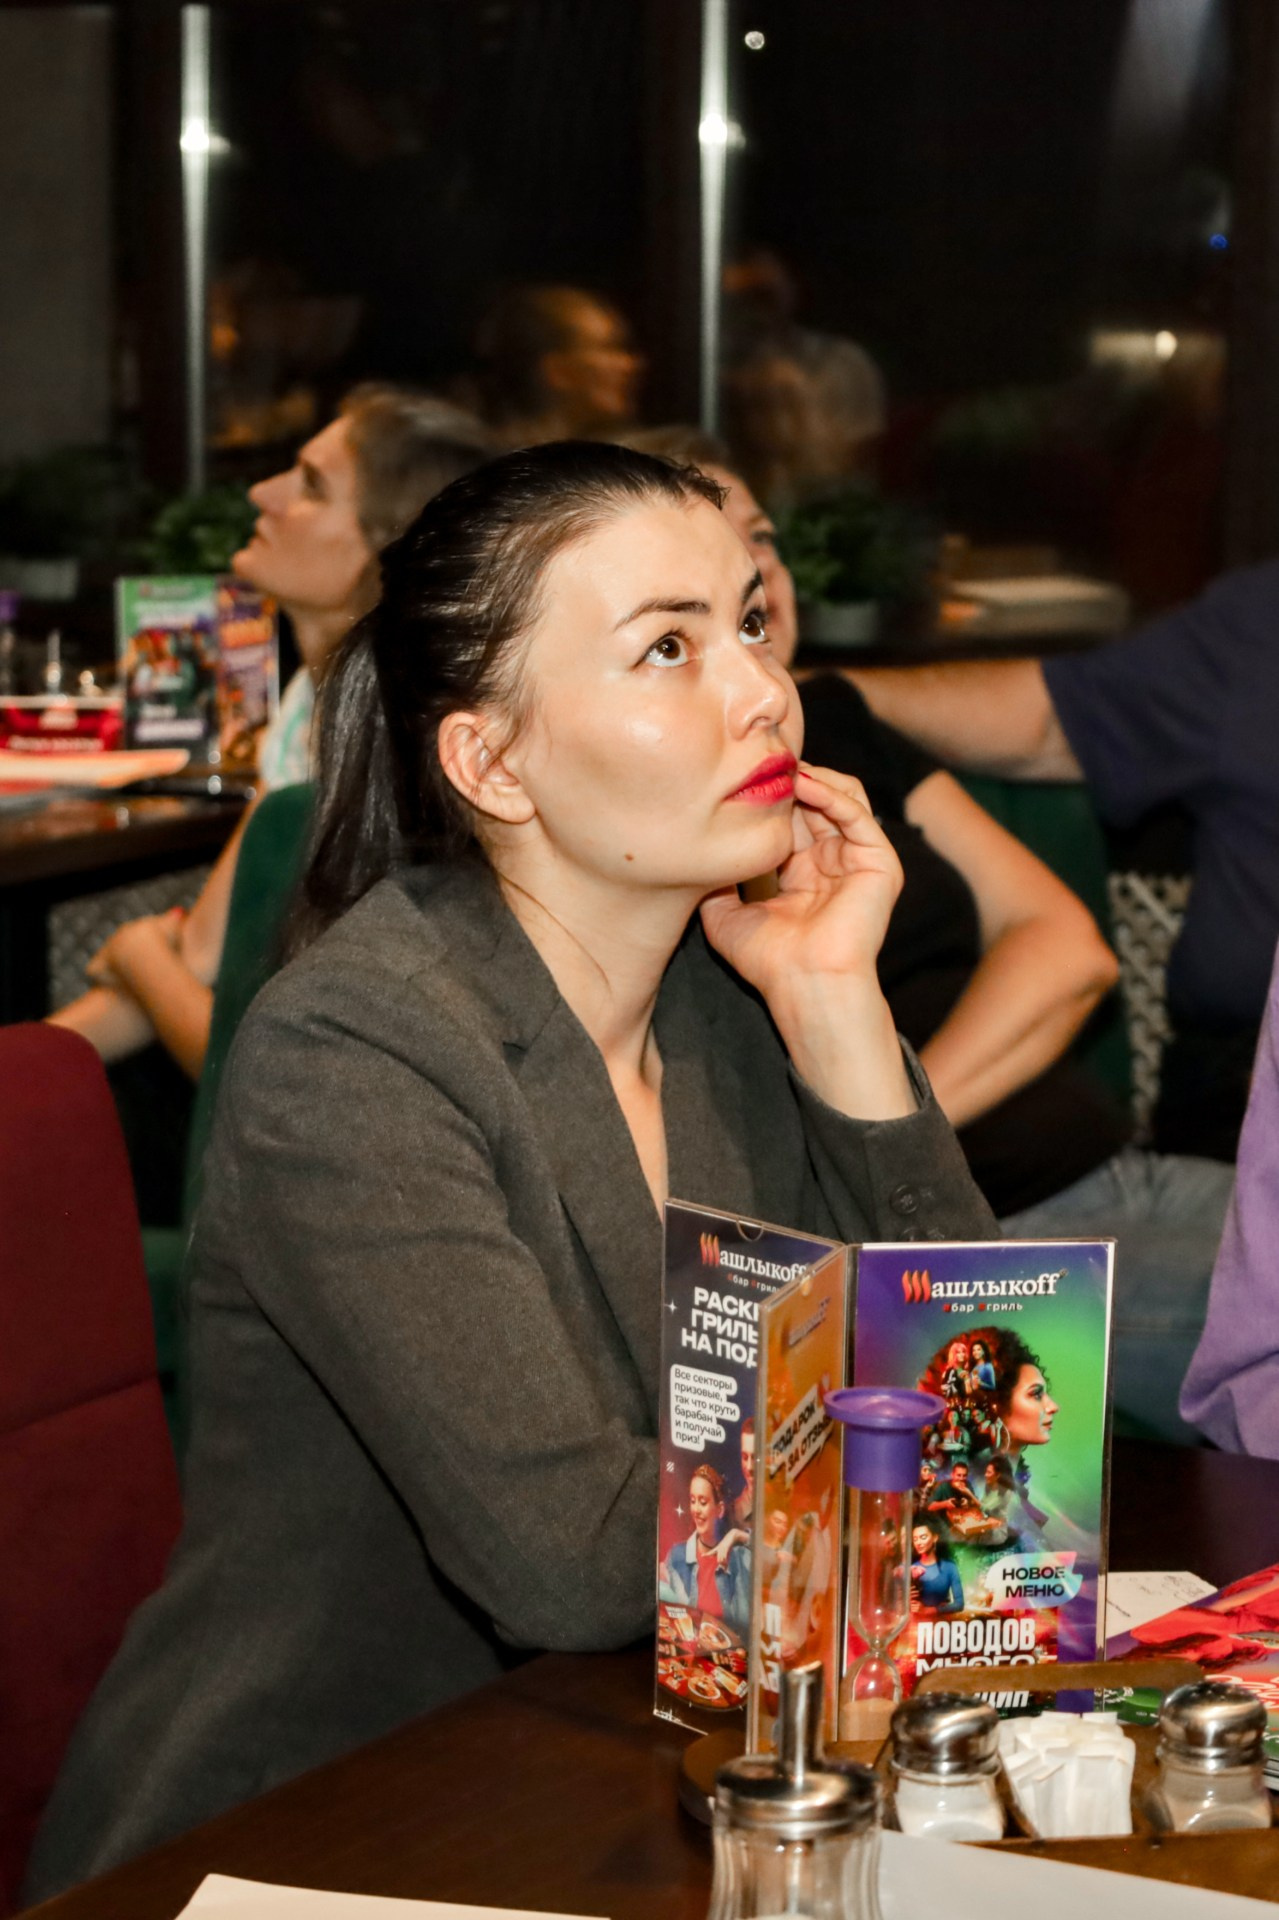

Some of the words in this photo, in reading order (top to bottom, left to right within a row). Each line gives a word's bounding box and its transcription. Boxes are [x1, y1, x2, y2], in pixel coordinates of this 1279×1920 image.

[681, 1327, 713, 1355] НА
[674, 1368, 691, 1380] Все
[693, 1374, 733, 1390] секторы
[674, 1382, 723, 1401] призовые,
[674, 1405, 713, 1423] барабан
[675, 1395, 690, 1405] так
[691, 1399, 707, 1409] что
[709, 1403, 736, 1416] крути
[676, 1431, 700, 1444] приз!
[683, 1422, 722, 1437] получай
[1002, 1566, 1065, 1581] НОВОЕ
[1005, 1583, 1065, 1598] МЕНЮ
[917, 1618, 1036, 1656] ПОВОДОВ
